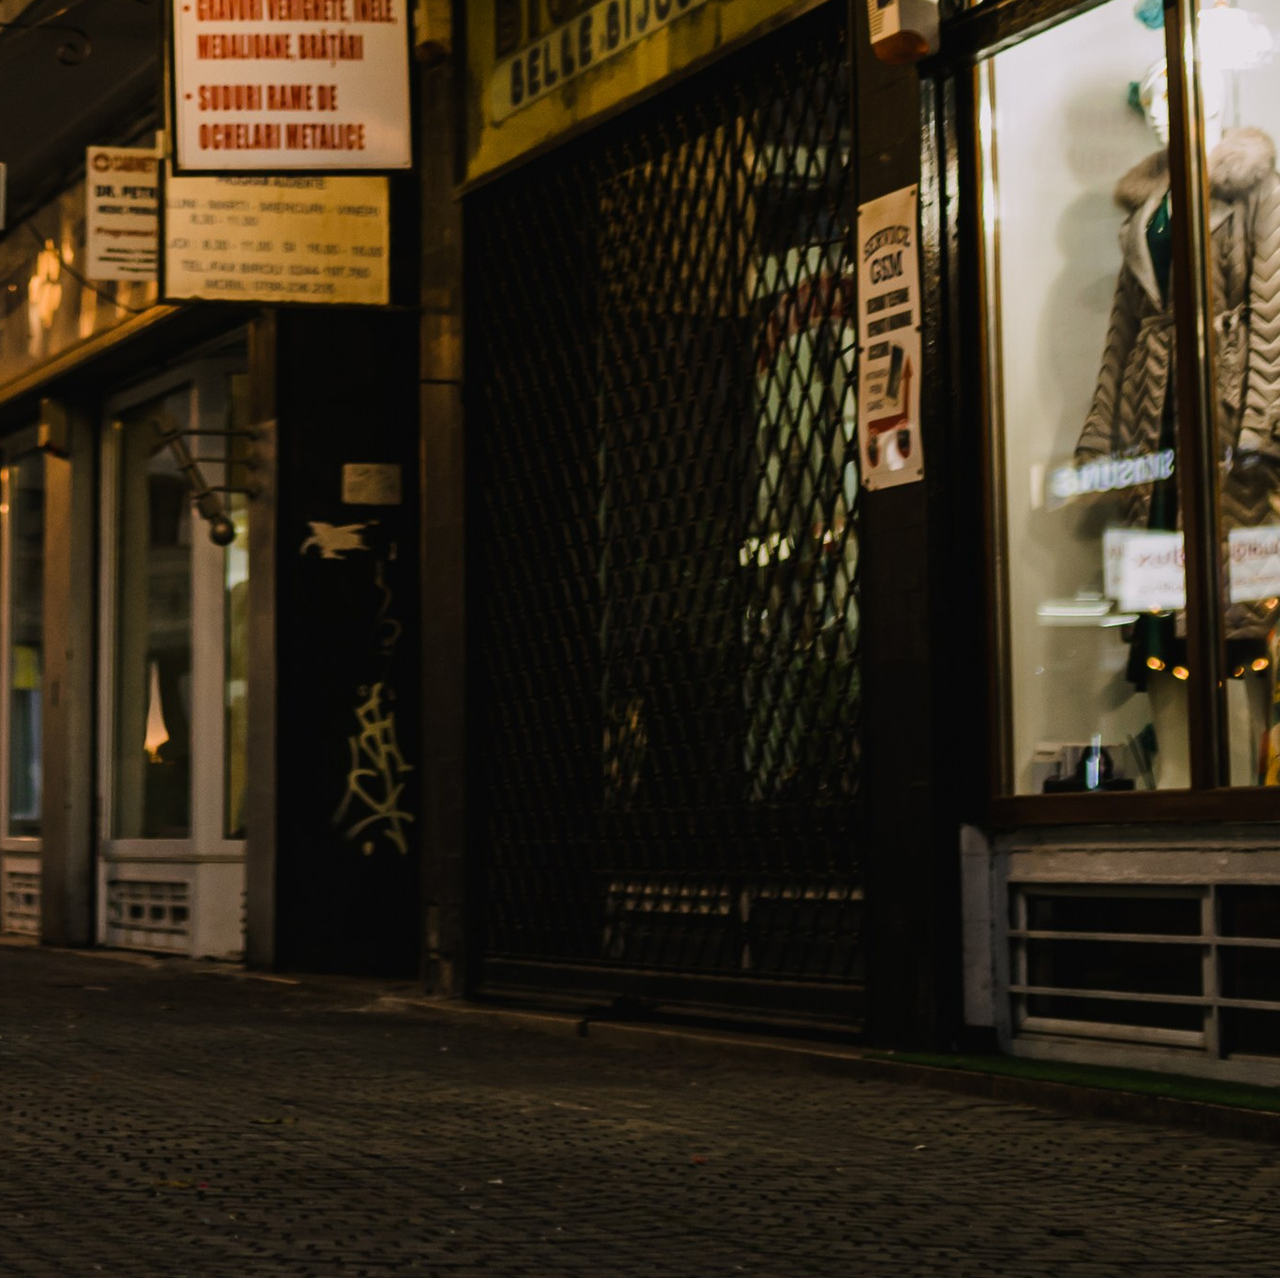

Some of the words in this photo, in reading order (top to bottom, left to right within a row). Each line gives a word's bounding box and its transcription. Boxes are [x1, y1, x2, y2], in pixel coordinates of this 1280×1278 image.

[509, 15, 595, 107] BELLE
[198, 85, 262, 111] SUDURI
[267, 85, 313, 111] RAME
[317, 85, 338, 111] DE
[199, 123, 280, 150] OCHELARI
[285, 123, 365, 150] METALICE
[870, 250, 903, 285] GSM
